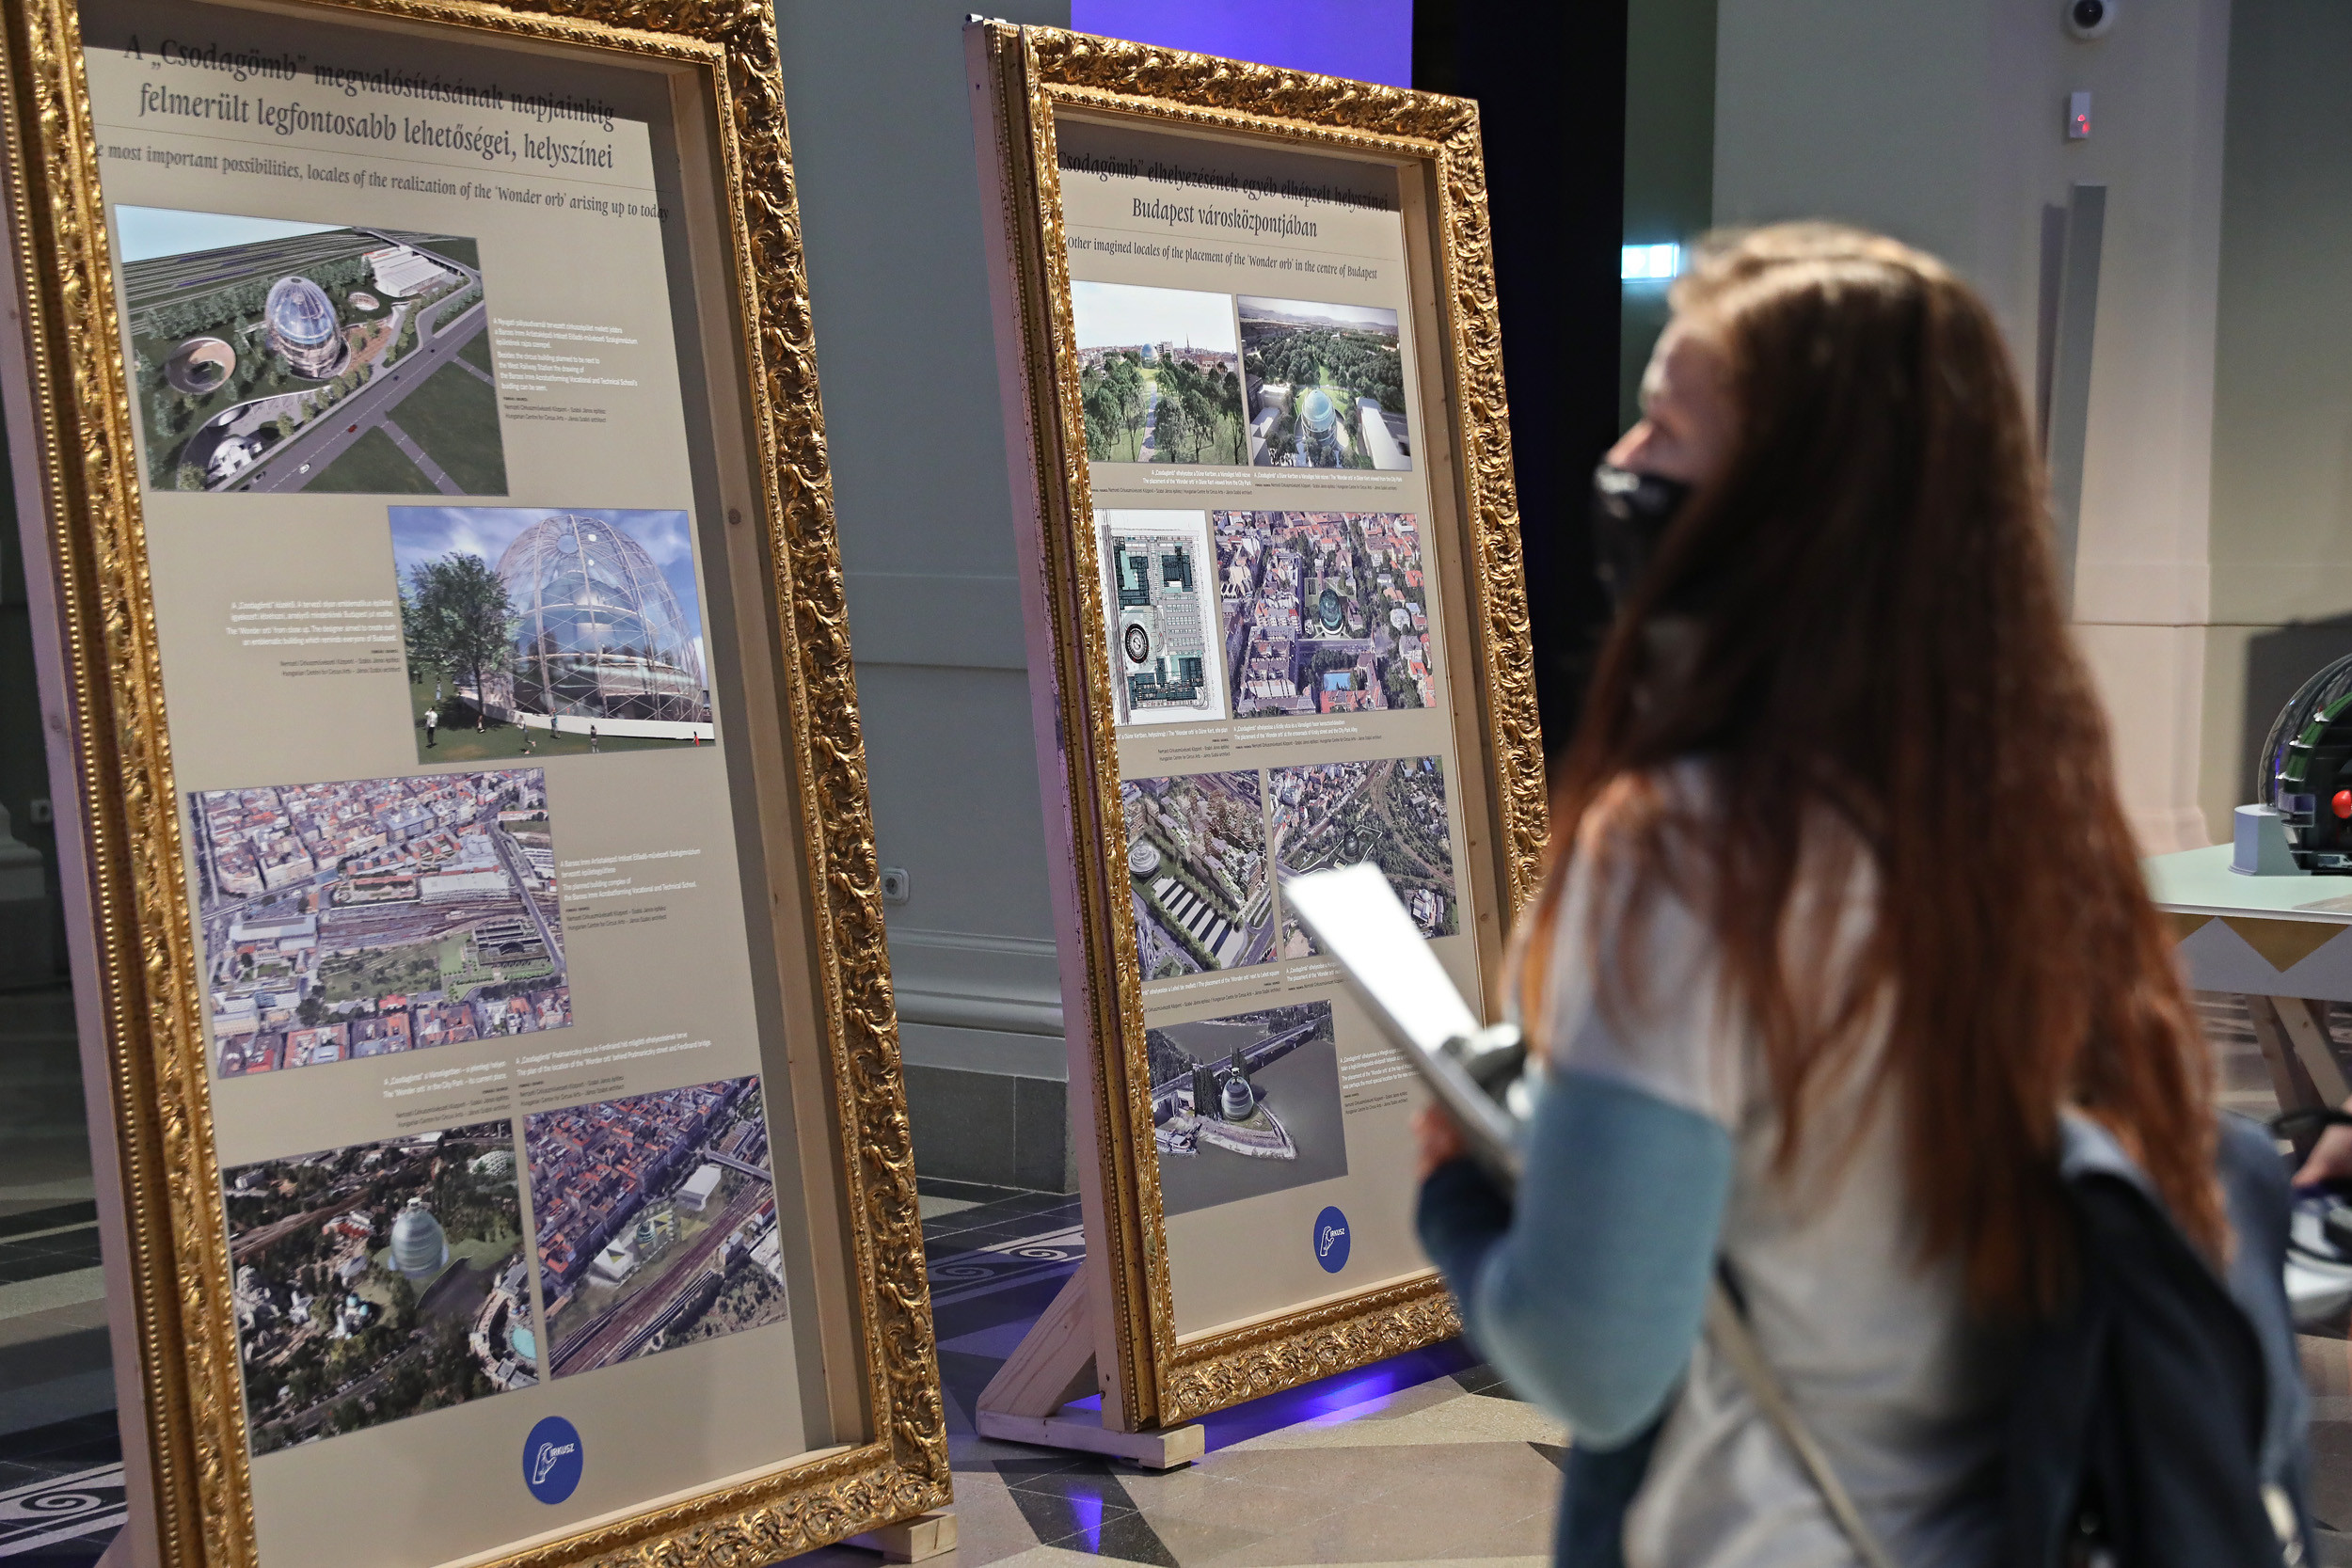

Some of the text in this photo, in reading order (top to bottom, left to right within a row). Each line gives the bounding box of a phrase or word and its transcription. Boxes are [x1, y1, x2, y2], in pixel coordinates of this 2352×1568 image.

[124, 35, 144, 60] A
[313, 62, 504, 110] megvalósításának
[511, 91, 614, 132] napjainkig
[138, 83, 613, 168] felmerült legfontosabb lehetőségei, helyszínei
[108, 145, 142, 161] most
[146, 146, 219, 169] important
[222, 157, 303, 180] possibilities,
[307, 164, 349, 184] locales
[354, 169, 368, 188] of
[368, 171, 388, 188] the
[391, 176, 456, 196] realization
[460, 182, 473, 200] of
[474, 183, 492, 199] the
[569, 197, 609, 215] arising
[612, 203, 625, 217] up
[628, 204, 639, 216] to
[641, 203, 670, 223] today
[1057, 150, 1389, 213] Csodagömb” elhelyezésének egyéb elképzelt helyszínei
[1133, 198, 1318, 239] Budapest városközpontjában
[1068, 236, 1092, 250] Other
[1093, 238, 1132, 255] imagined
[1134, 243, 1160, 257] locales
[1162, 245, 1171, 260] of
[1171, 246, 1184, 260] the
[1185, 248, 1223, 262] placement
[1225, 252, 1233, 266] of
[1234, 253, 1246, 265] the
[1295, 259, 1303, 271] in
[1304, 260, 1315, 273] the
[1317, 263, 1338, 276] centre
[1339, 264, 1347, 278] of
[1347, 265, 1377, 281] Budapest
